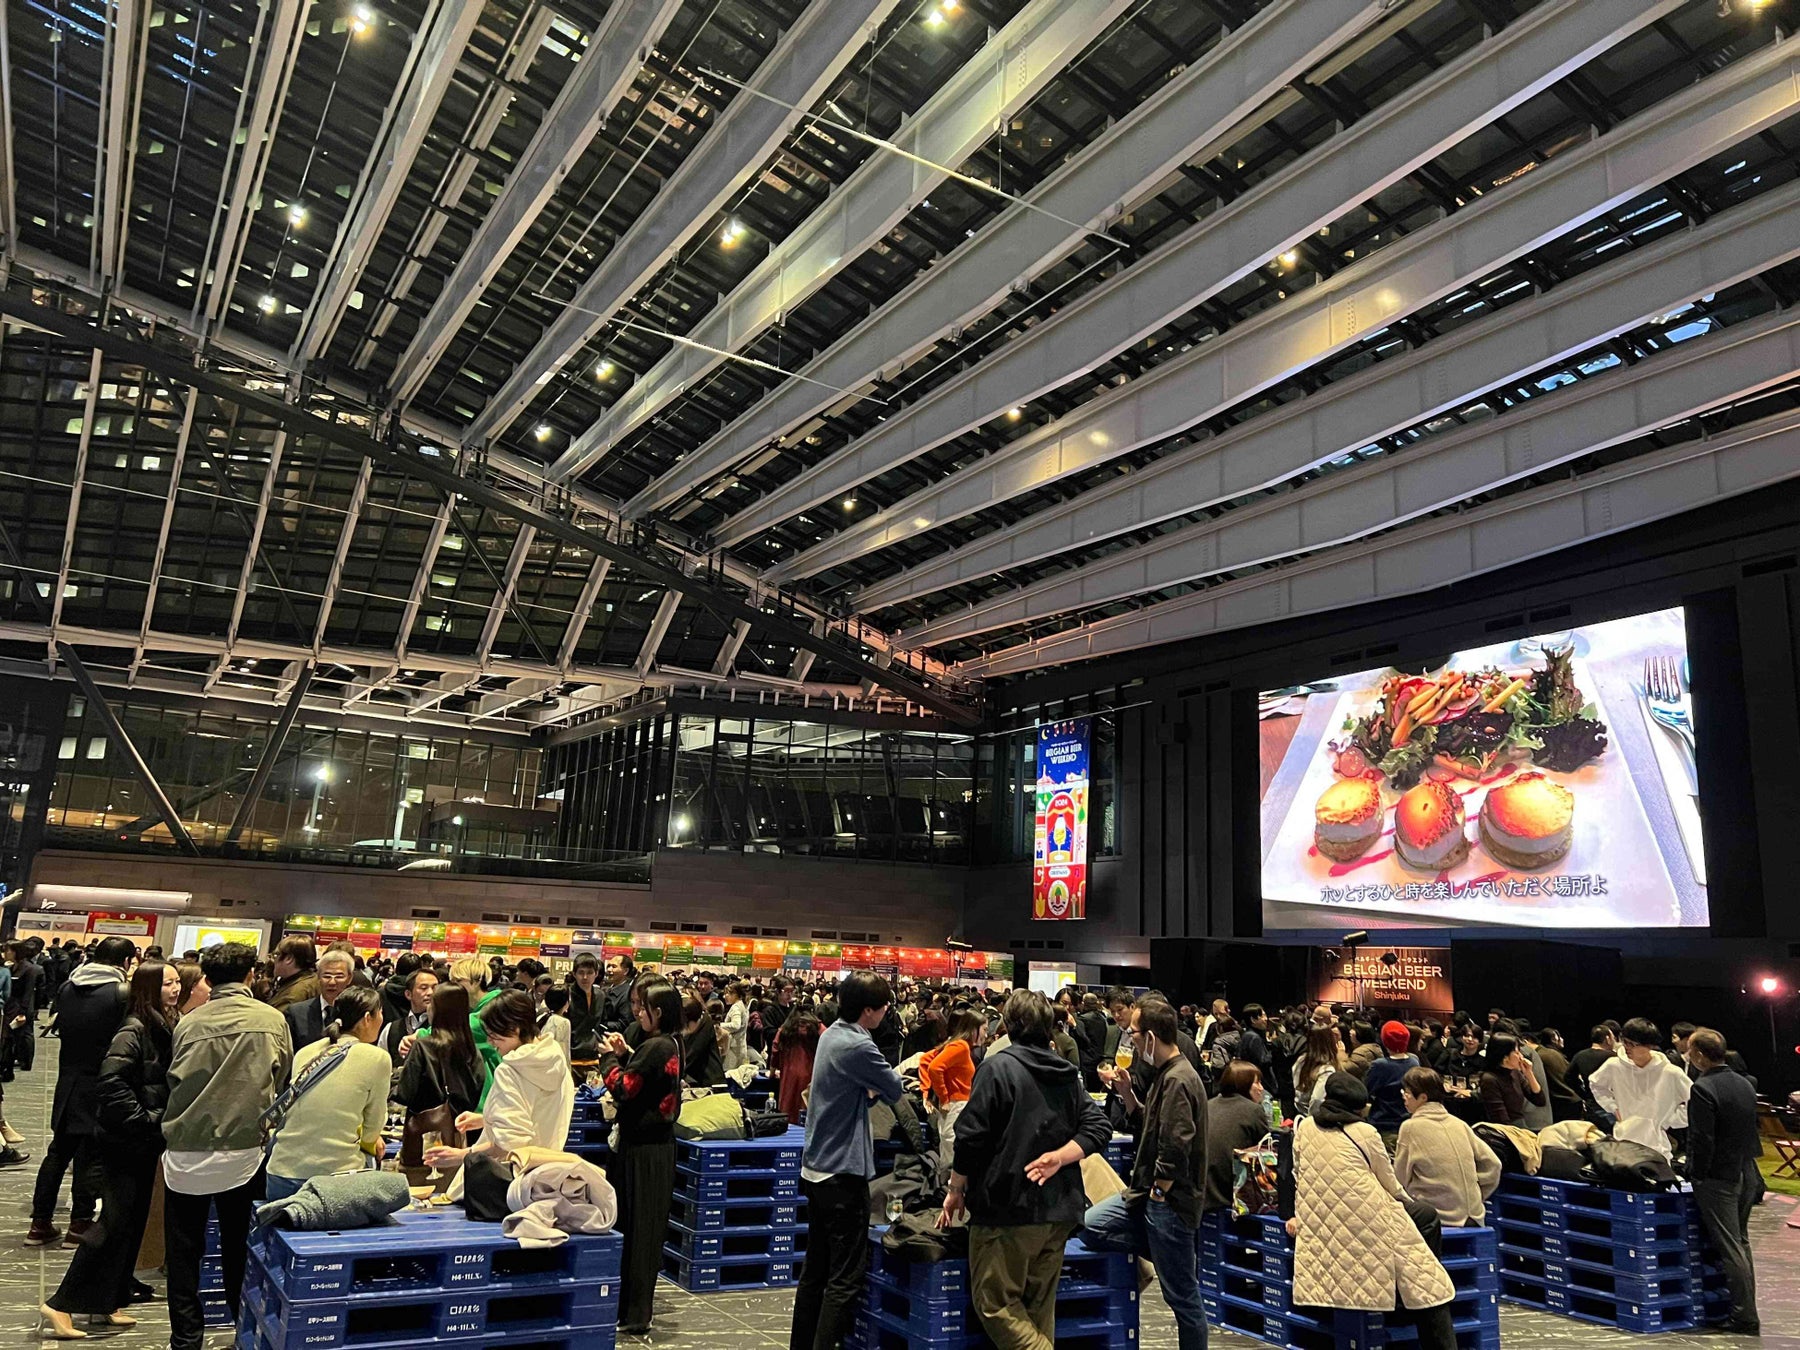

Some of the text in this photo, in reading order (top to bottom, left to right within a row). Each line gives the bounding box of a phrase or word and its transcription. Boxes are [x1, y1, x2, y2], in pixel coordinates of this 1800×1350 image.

[1320, 875, 1608, 902] ホッとするひと時を楽しんでいただく場所よ
[1343, 964, 1443, 978] BELGIAN BEER
[1360, 978, 1427, 990] WEEKEND
[1374, 991, 1410, 1001] Shinjuku
